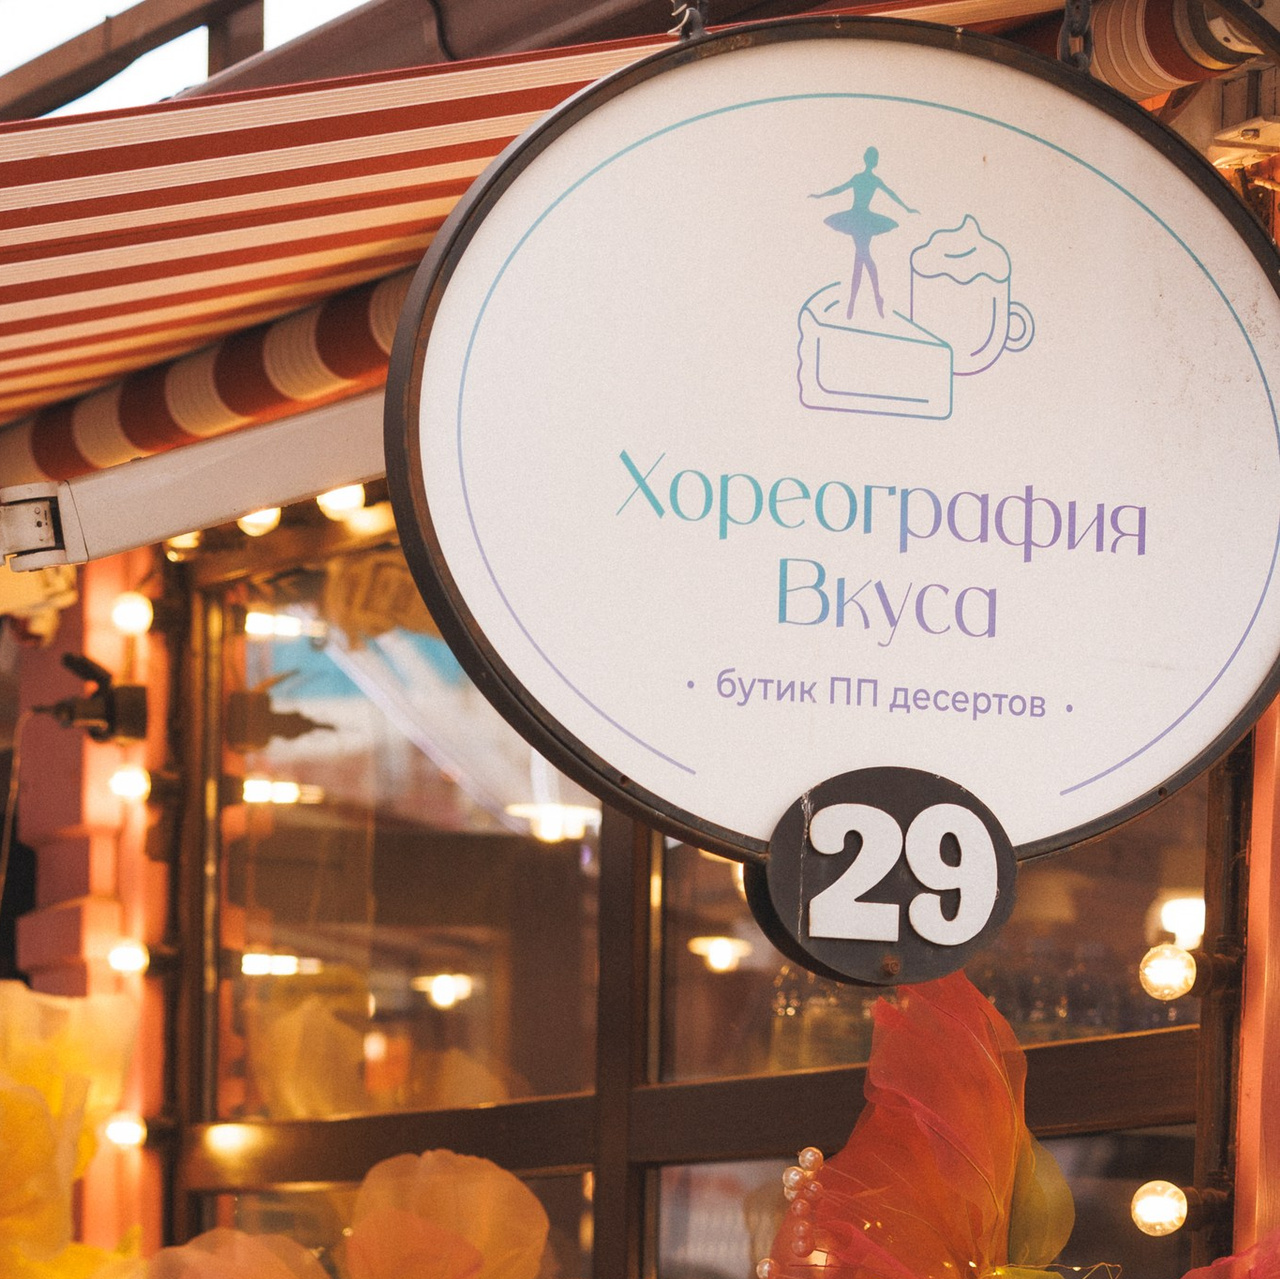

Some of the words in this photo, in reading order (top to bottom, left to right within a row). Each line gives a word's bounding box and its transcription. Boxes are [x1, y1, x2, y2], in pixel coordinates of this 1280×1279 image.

[616, 449, 1148, 564] Хореография
[777, 557, 999, 648] Вкуса
[716, 667, 818, 706] бутик
[829, 676, 879, 707] ПП
[888, 685, 1048, 720] десертов
[808, 803, 999, 947] 29
